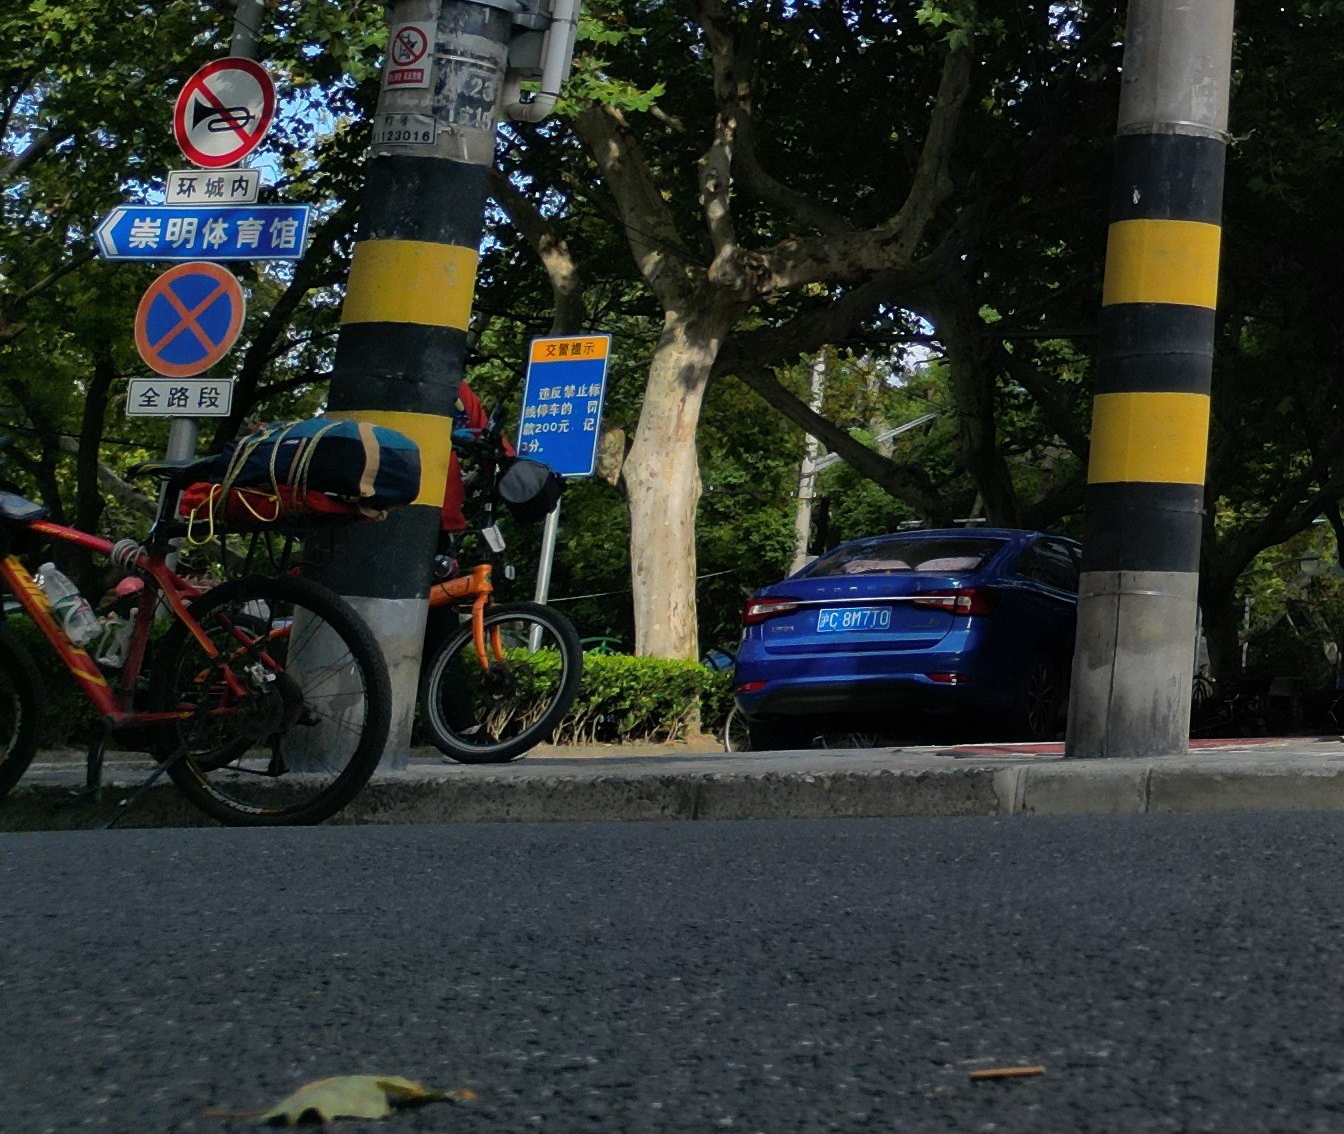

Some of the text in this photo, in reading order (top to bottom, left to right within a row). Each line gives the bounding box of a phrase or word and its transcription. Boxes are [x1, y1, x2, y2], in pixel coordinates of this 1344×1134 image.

[175, 175, 250, 198] 环城内
[128, 216, 300, 250] 崇明体育馆
[545, 342, 596, 357] 交警提示
[138, 386, 221, 409] 全路段
